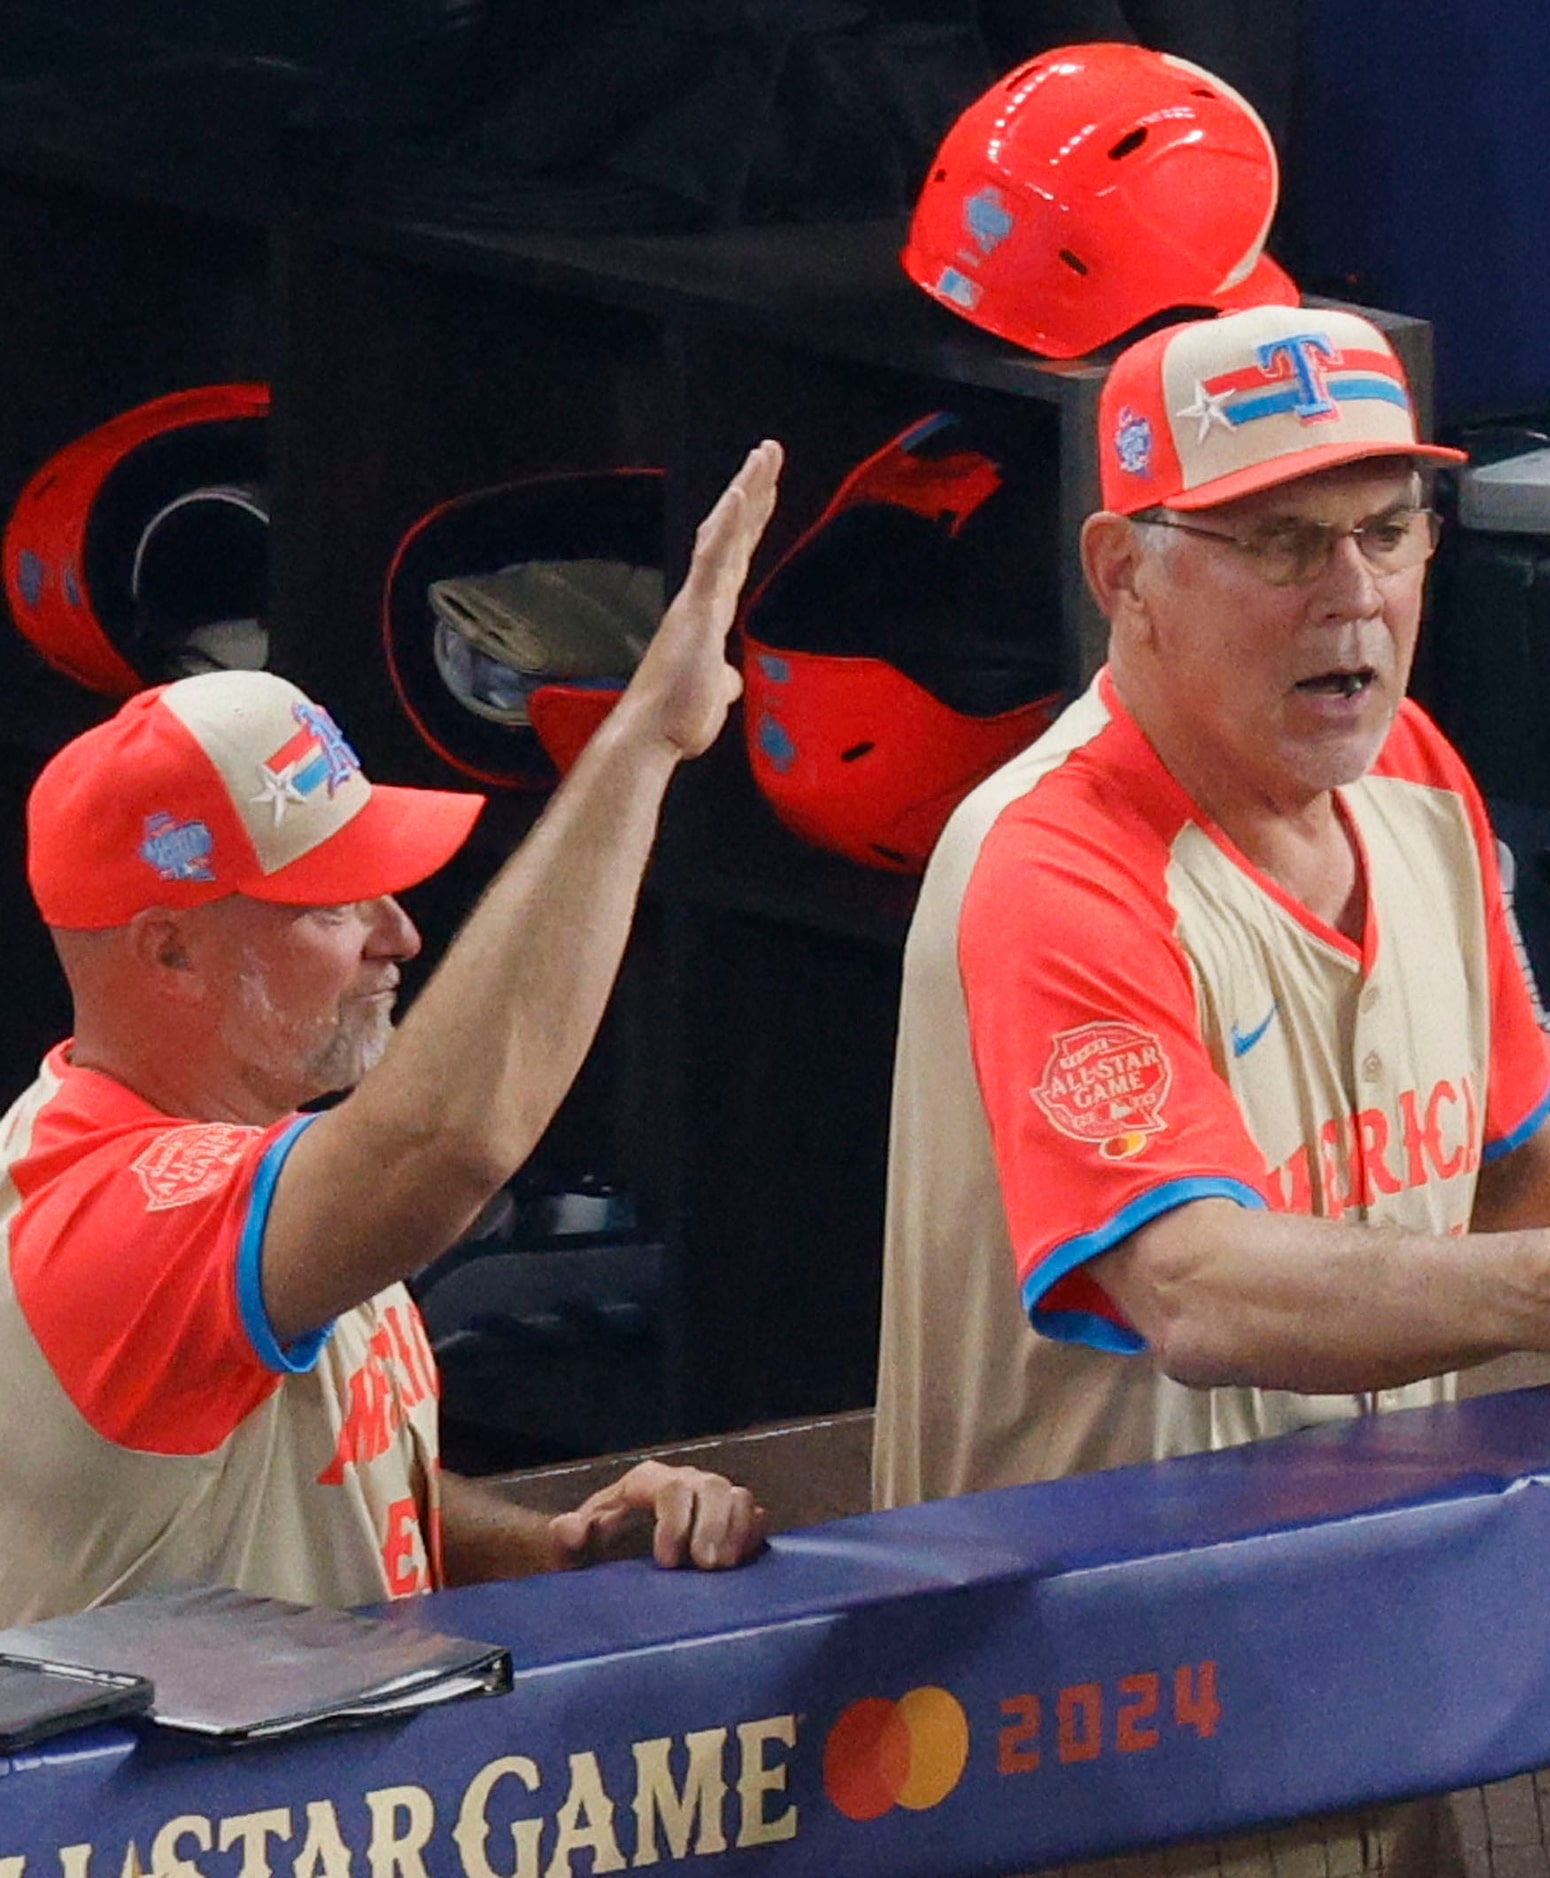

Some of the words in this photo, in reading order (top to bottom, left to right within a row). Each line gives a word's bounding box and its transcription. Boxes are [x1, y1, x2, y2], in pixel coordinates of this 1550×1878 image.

[1256, 330, 1345, 426] T
[1073, 1071, 1145, 1109] GAME
[996, 1659, 1222, 1775] 2024
[449, 1714, 801, 1878] GAME
